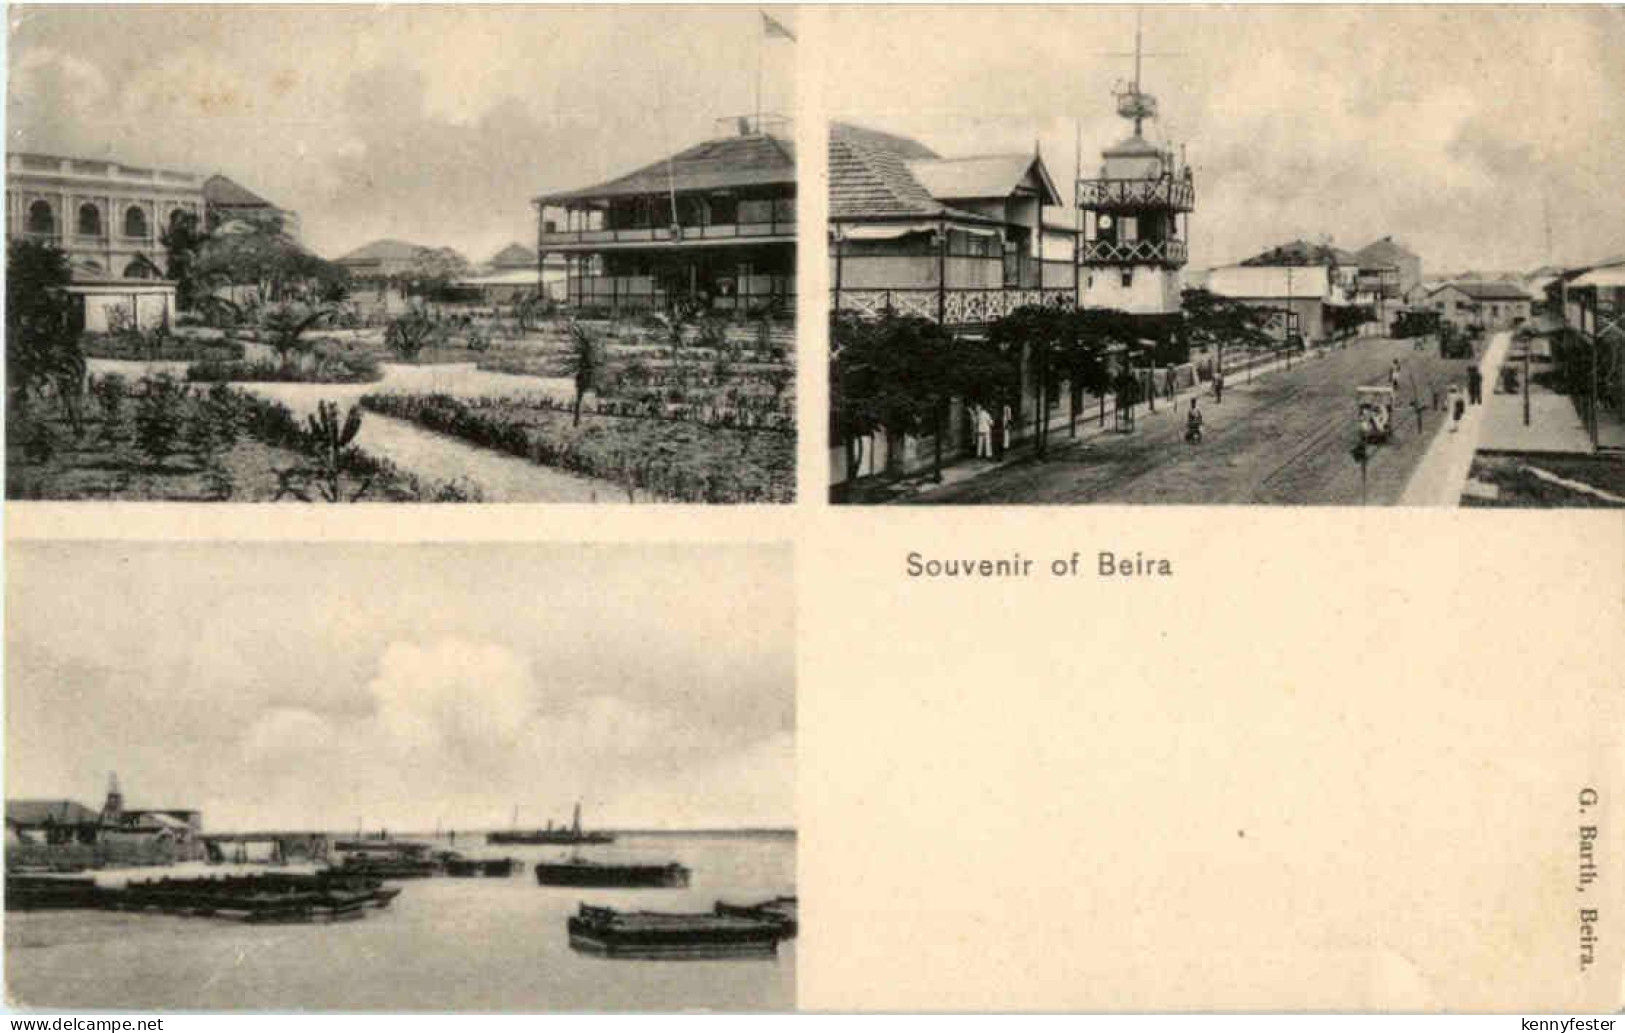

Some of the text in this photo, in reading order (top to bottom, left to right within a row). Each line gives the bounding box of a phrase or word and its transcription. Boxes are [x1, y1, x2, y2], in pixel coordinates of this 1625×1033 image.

[906, 552, 1173, 577] Souvenir of Beira
[1576, 788, 1598, 971] G. Barth, Beira.
